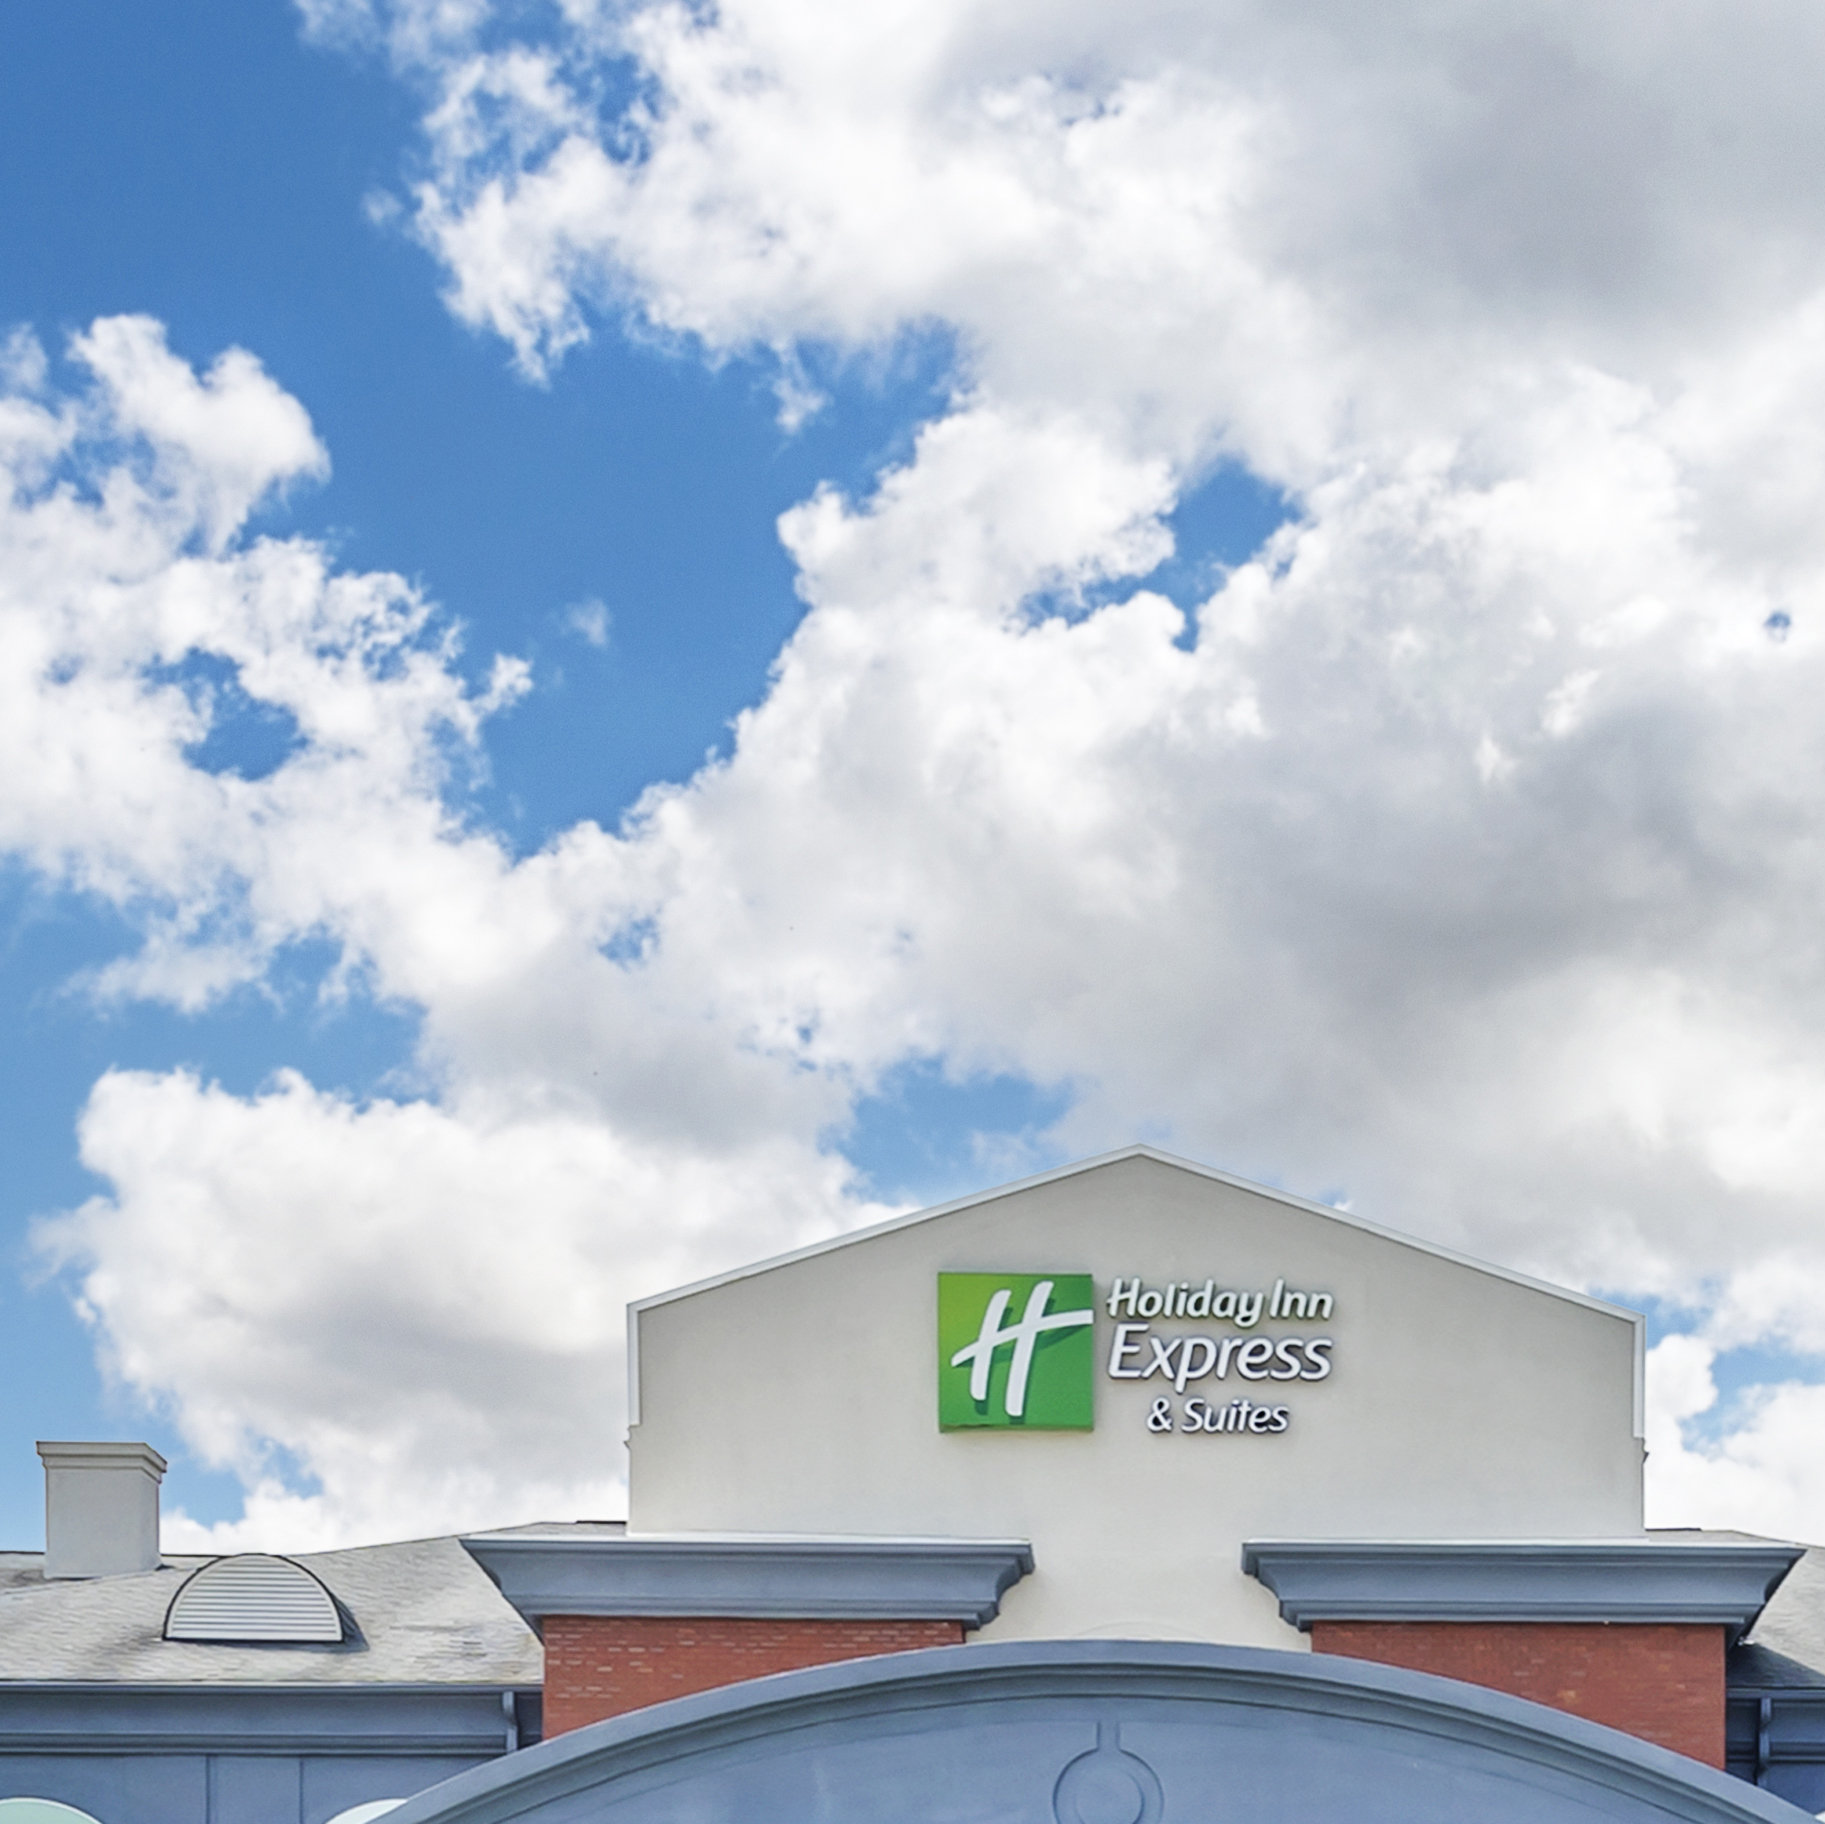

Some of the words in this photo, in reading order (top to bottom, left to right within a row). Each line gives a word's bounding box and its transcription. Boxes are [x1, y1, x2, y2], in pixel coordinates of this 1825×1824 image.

[1106, 1277, 1264, 1328] Holiday
[1268, 1278, 1334, 1319] Inn
[1107, 1322, 1334, 1394] Express
[1146, 1396, 1173, 1433] &
[1180, 1397, 1290, 1433] Suites
